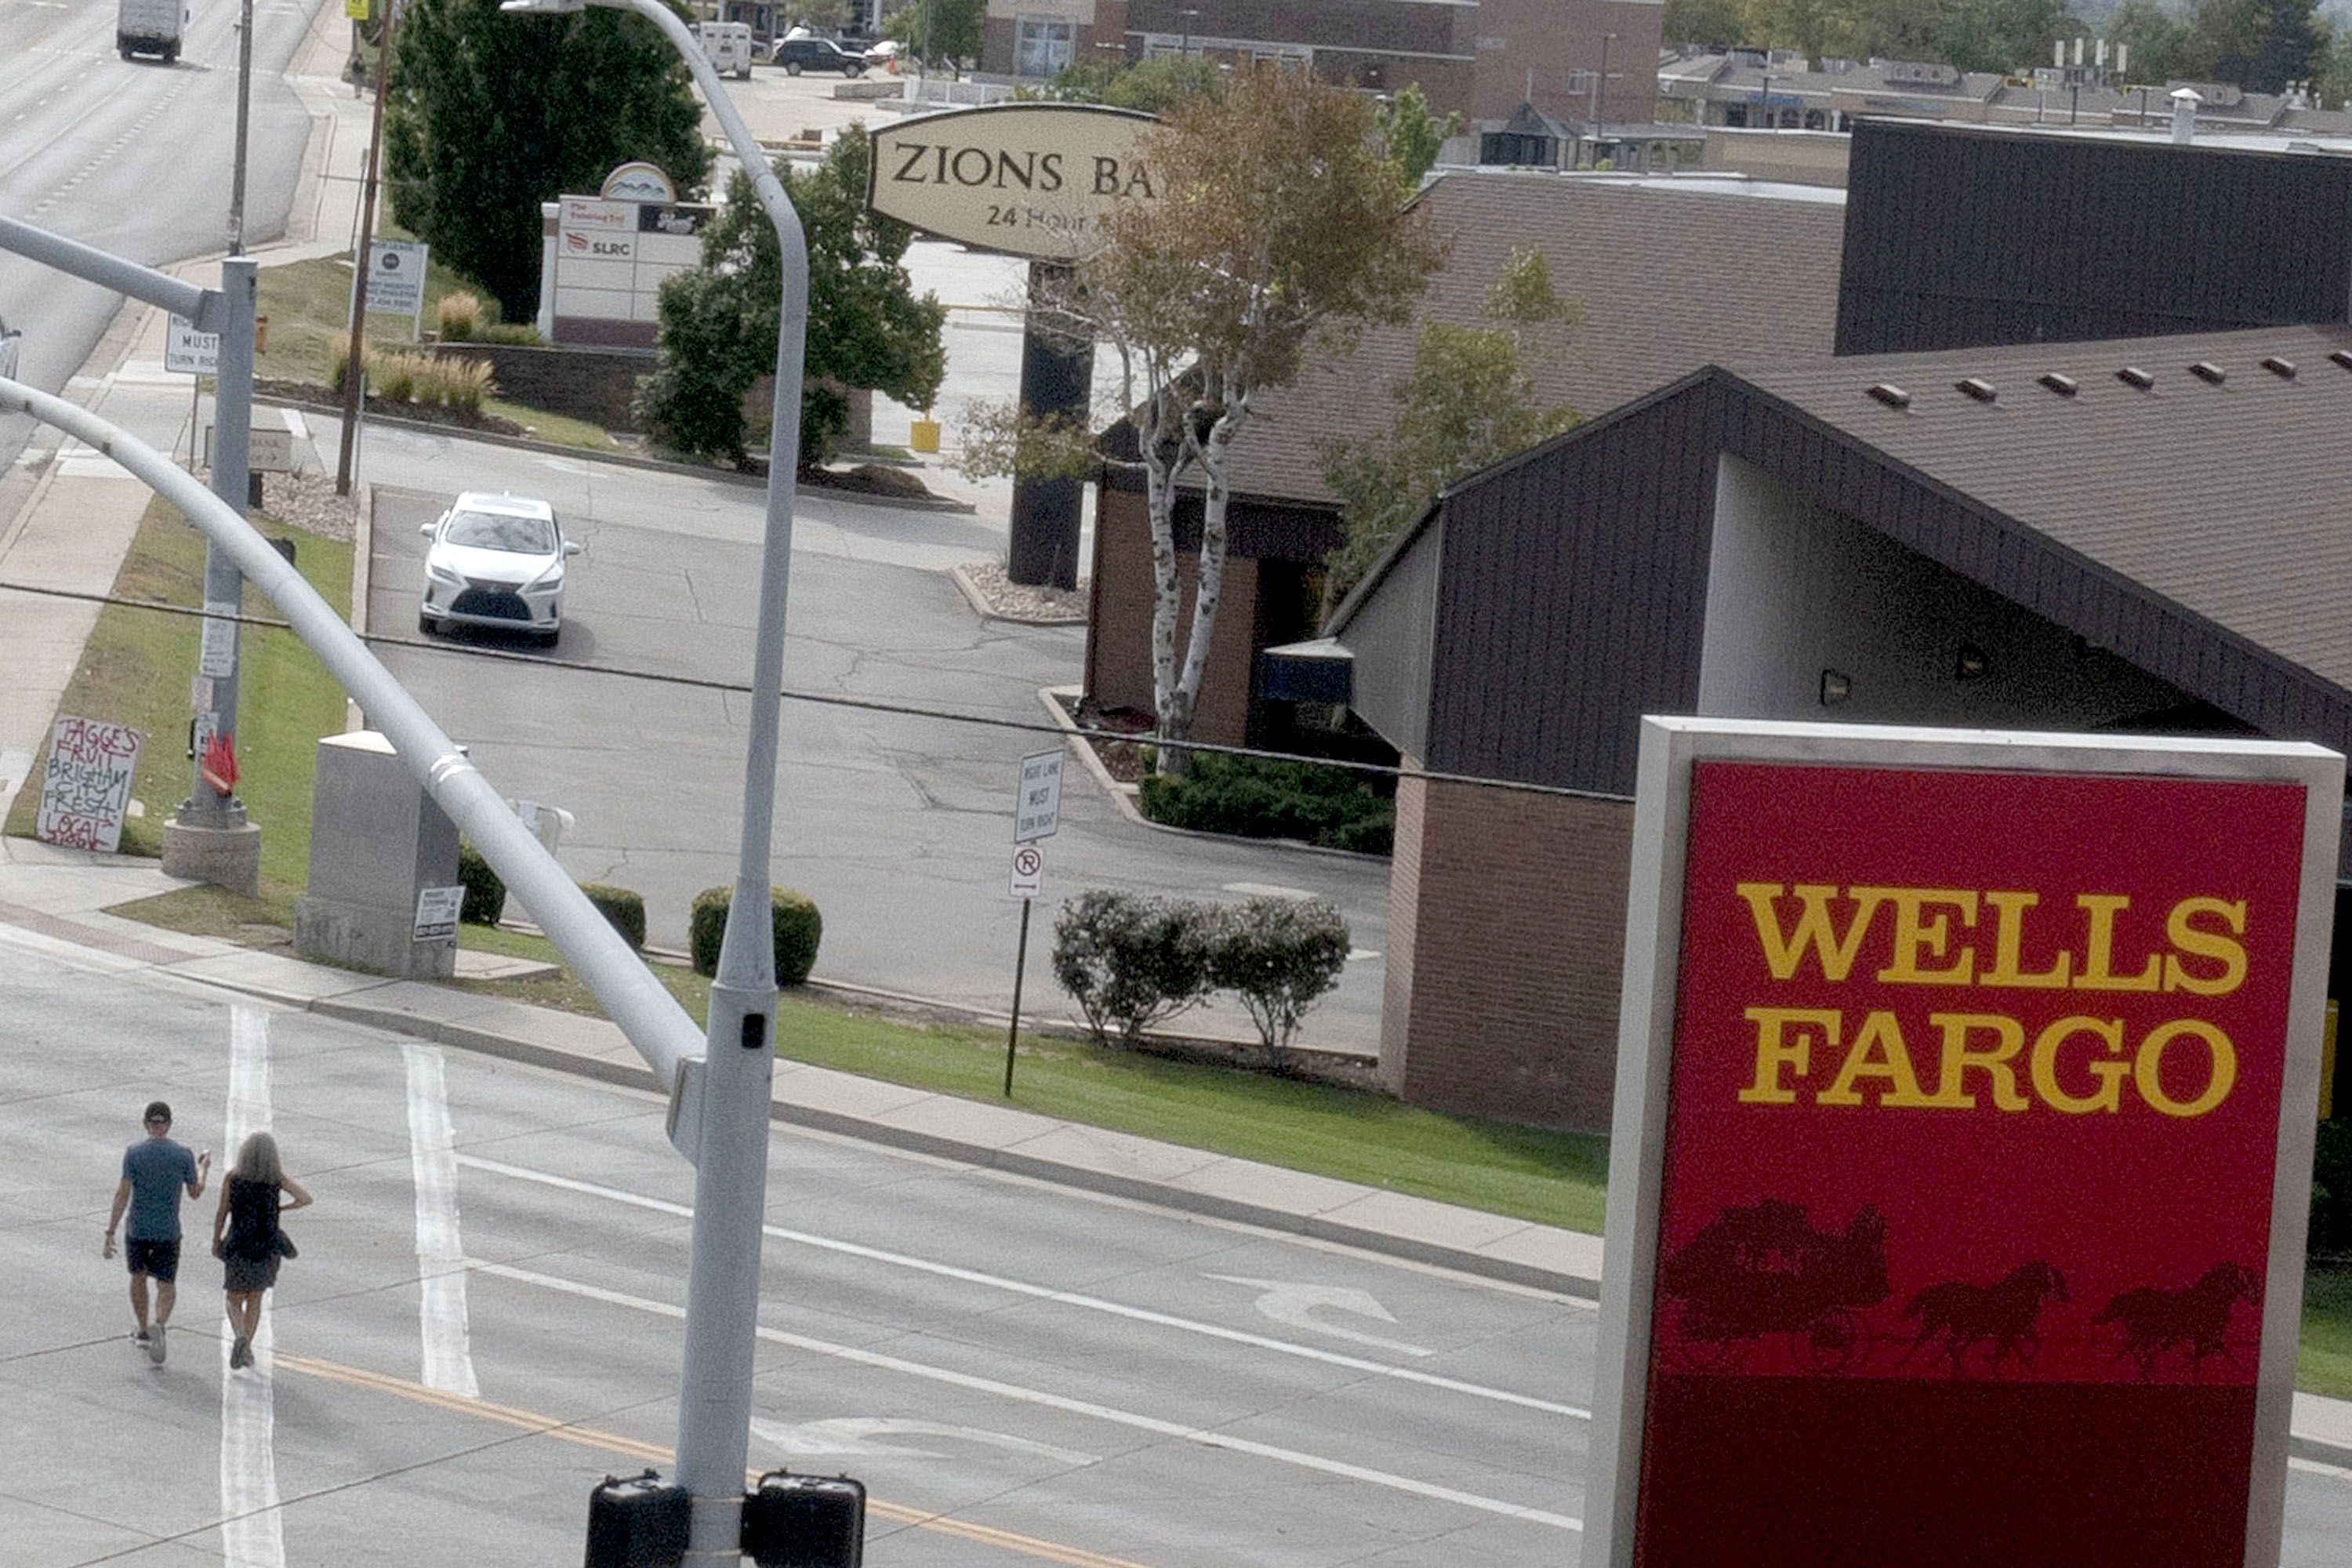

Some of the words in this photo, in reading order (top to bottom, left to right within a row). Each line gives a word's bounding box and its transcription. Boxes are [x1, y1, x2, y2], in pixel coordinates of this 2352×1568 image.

[892, 141, 1063, 191] ZIONS
[1089, 155, 1156, 198] BA
[986, 205, 1018, 227] 24
[1025, 207, 1086, 231] Hour
[592, 241, 631, 256] SLRC
[182, 334, 217, 350] MUST
[199, 355, 219, 367] RIG
[55, 739, 130, 768] FRUIT
[48, 757, 129, 789] BRIGHAM
[56, 780, 110, 802] CITY
[1736, 880, 2249, 996] WELLS
[1737, 1006, 2238, 1117] FARGO
